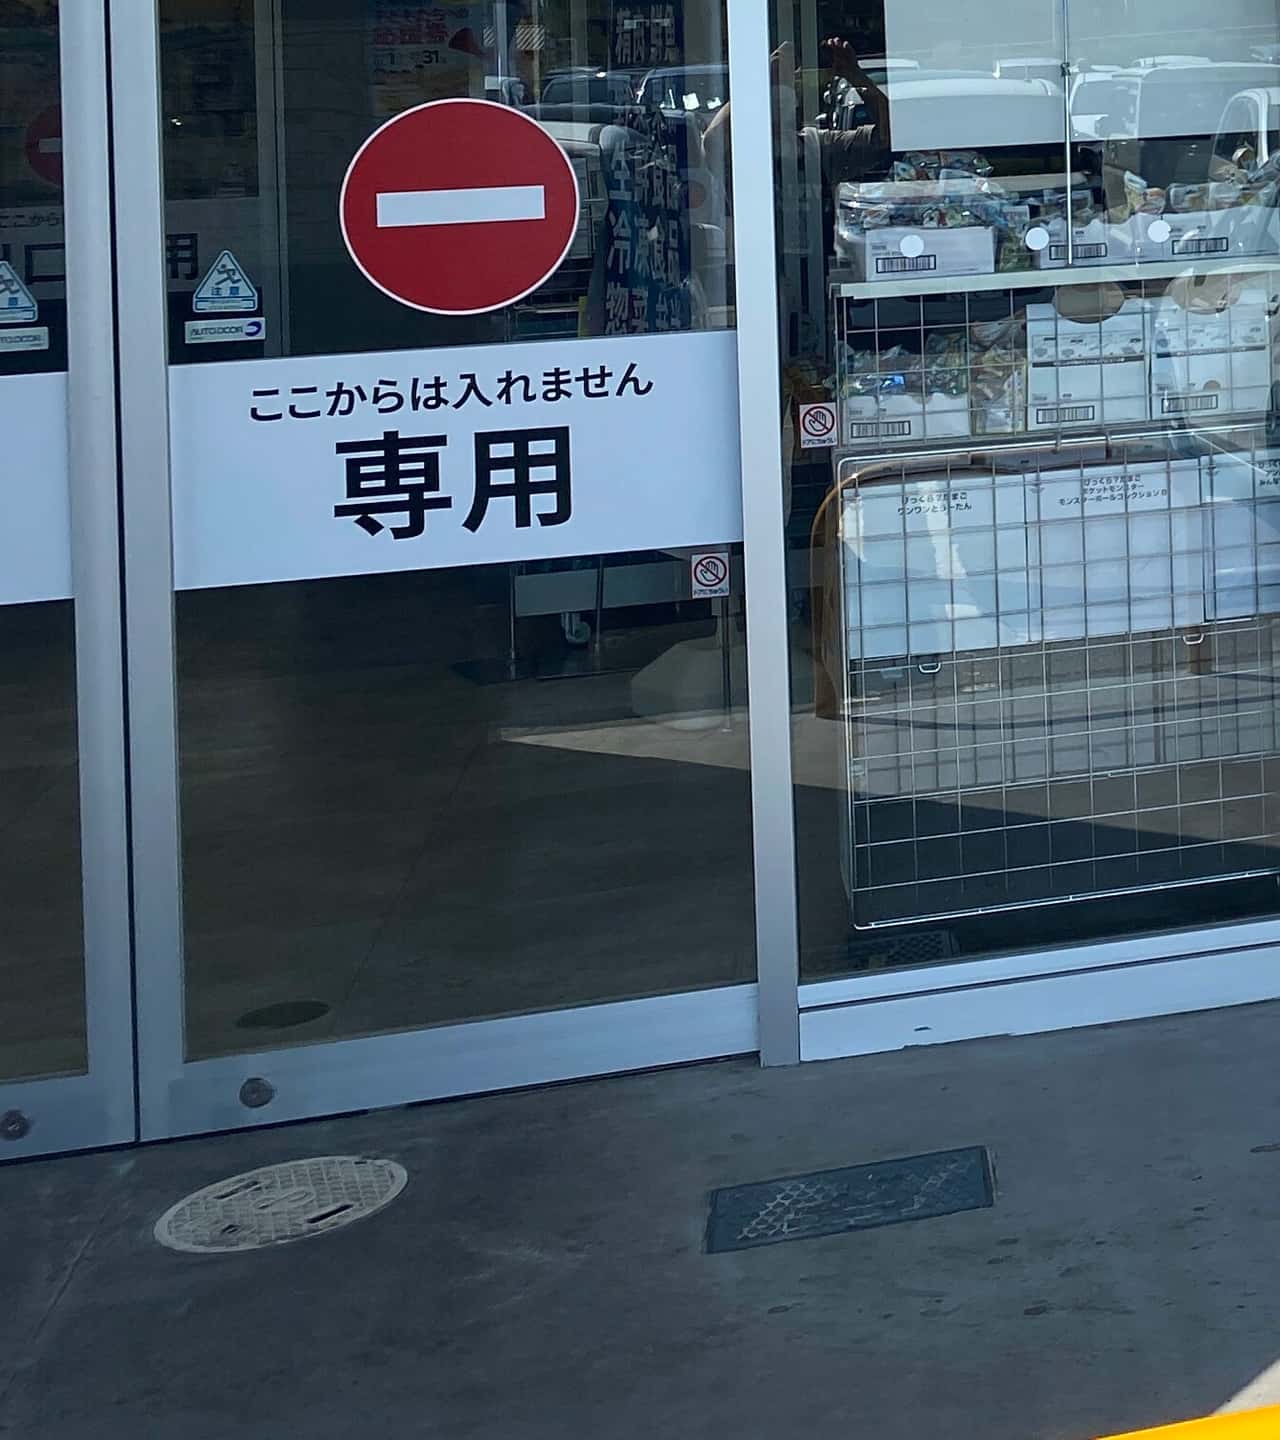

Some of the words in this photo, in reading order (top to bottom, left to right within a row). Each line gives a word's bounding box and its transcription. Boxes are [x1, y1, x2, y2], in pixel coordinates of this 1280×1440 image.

[249, 363, 653, 422] ここからは入れません
[333, 426, 572, 540] 専用
